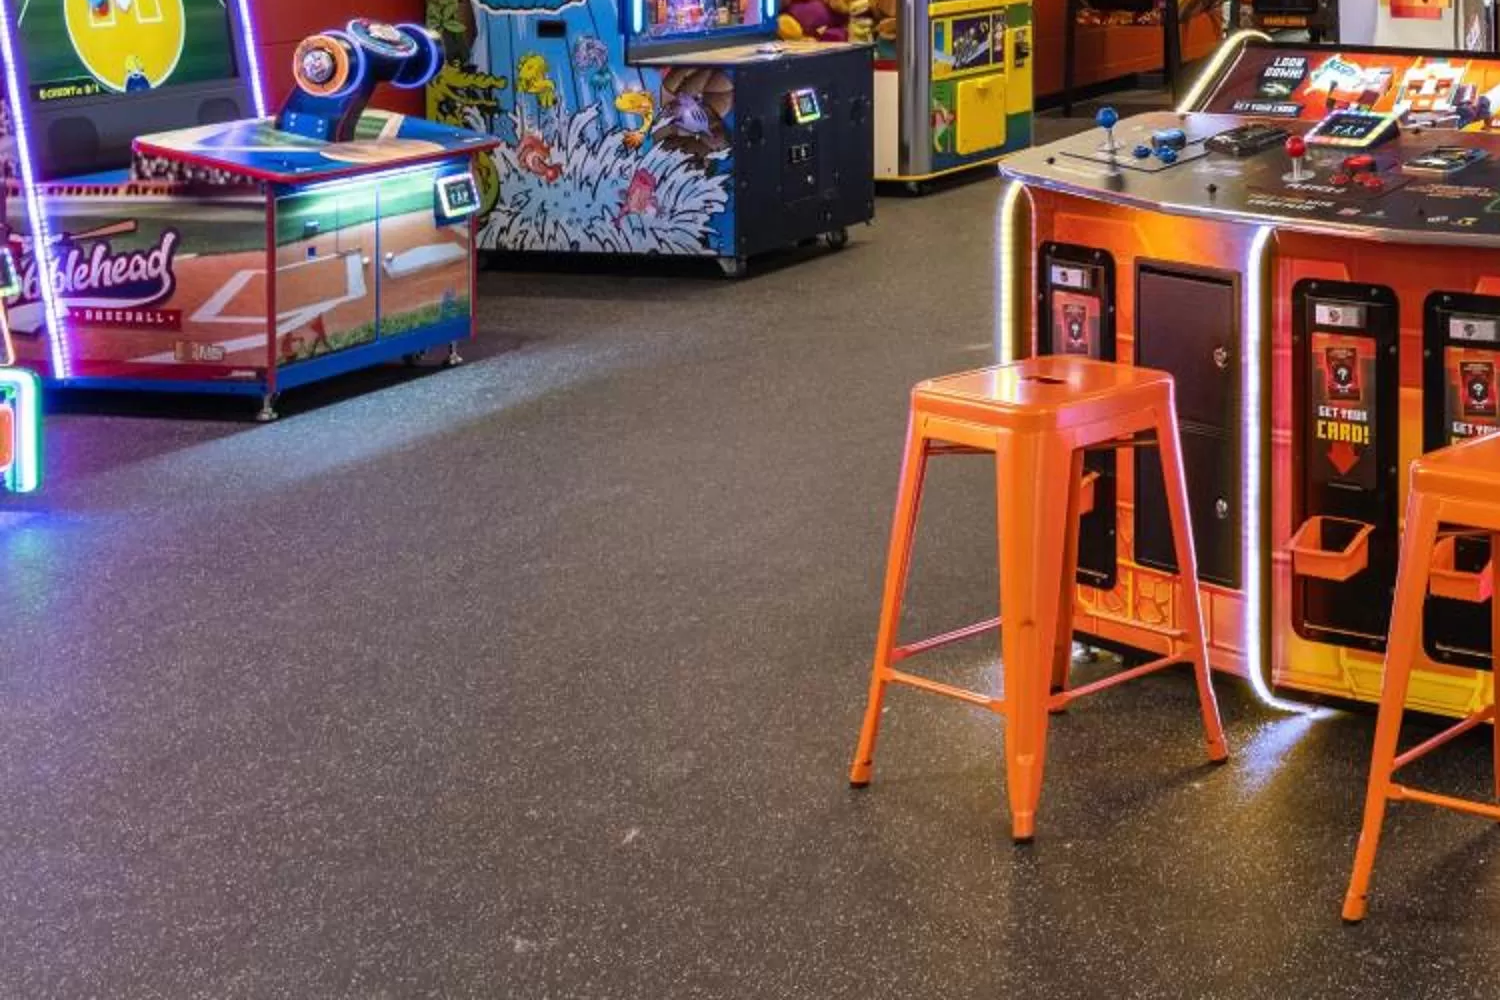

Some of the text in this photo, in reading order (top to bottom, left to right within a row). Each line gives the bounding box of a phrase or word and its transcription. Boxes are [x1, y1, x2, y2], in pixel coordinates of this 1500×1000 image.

[1274, 56, 1306, 67] LOOK
[85, 309, 164, 323] BASEBALL
[1318, 404, 1368, 422] GET YOUR
[1316, 419, 1370, 445] CARD!
[1453, 421, 1473, 435] GET
